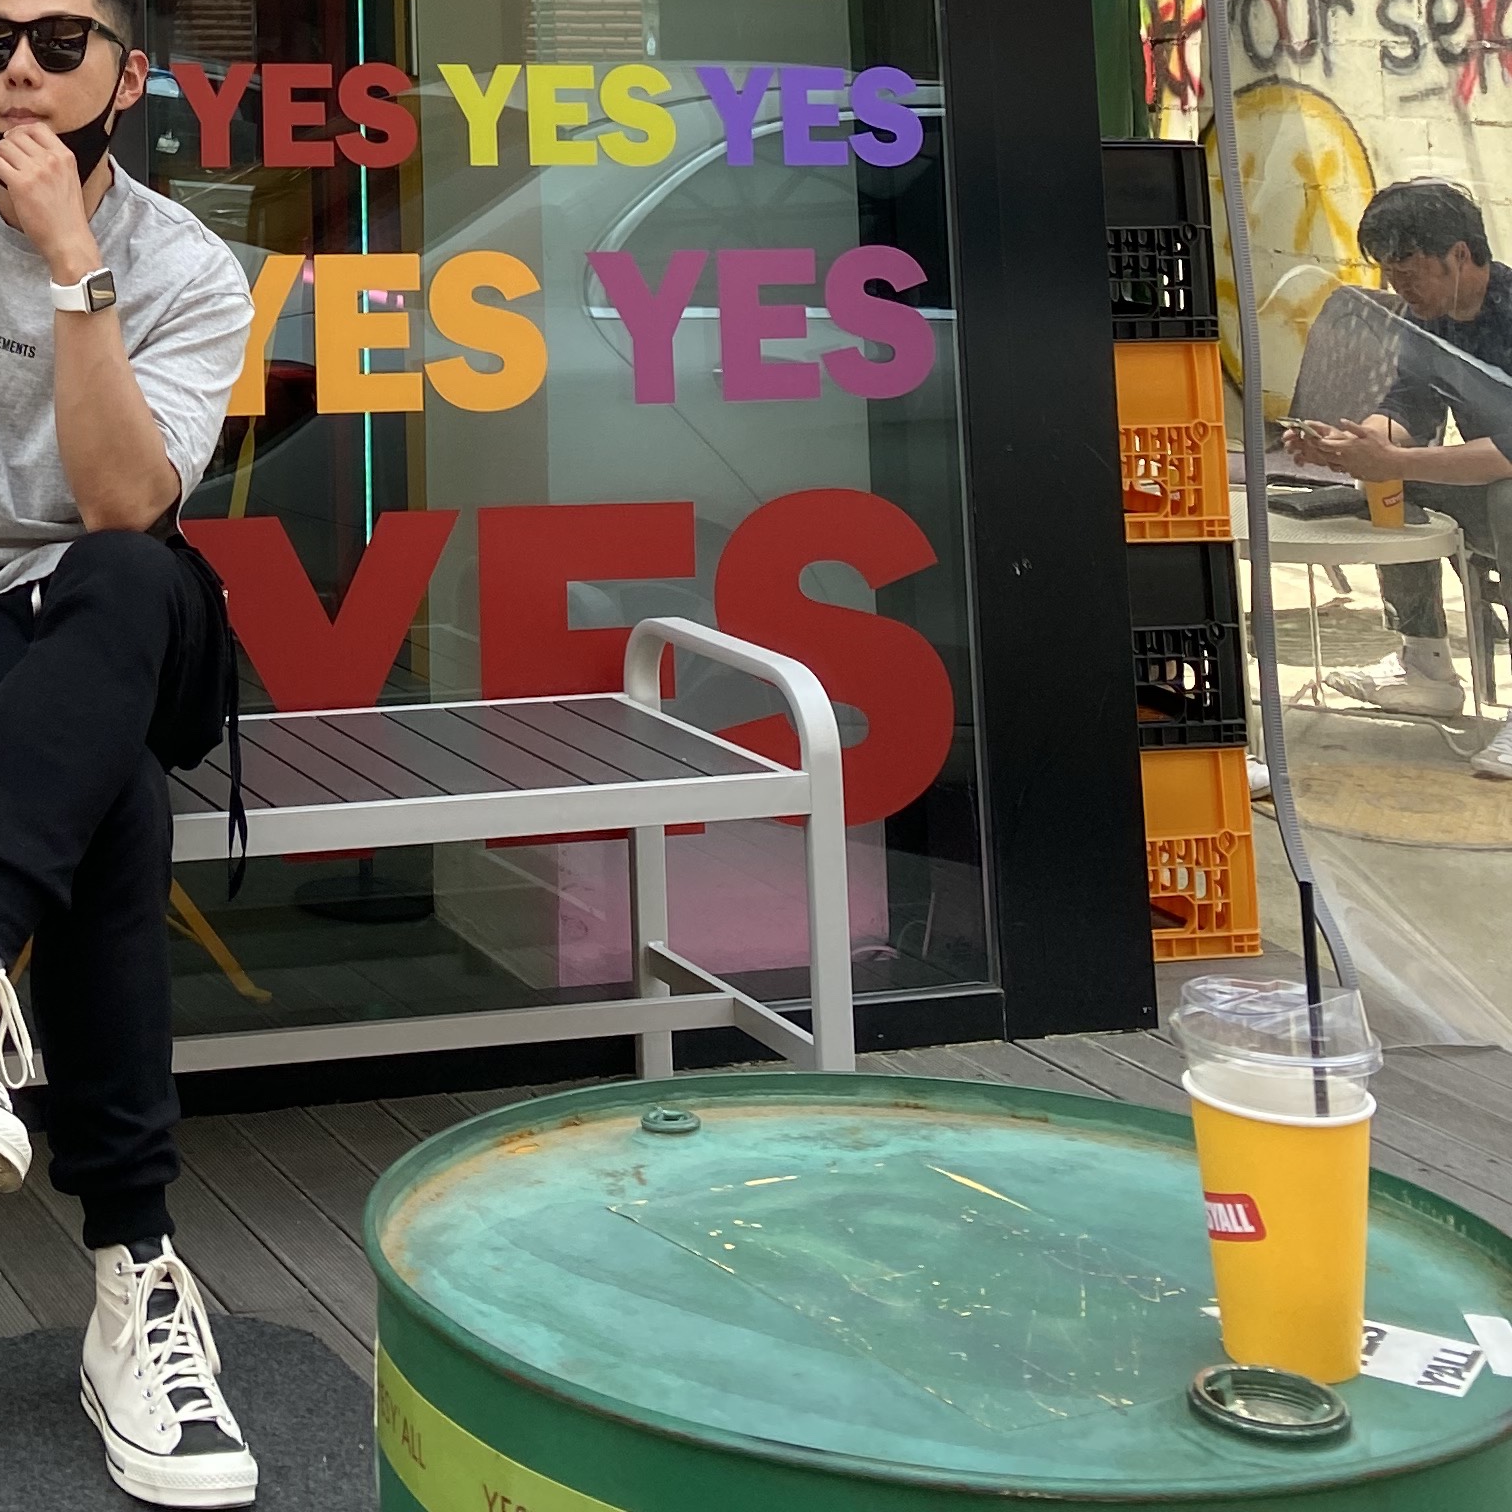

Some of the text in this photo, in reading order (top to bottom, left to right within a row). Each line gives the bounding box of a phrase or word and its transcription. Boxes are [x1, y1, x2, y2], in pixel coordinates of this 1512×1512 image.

[170, 62, 924, 169] YES YES YES
[586, 244, 936, 405] YES
[181, 488, 956, 864] YES
